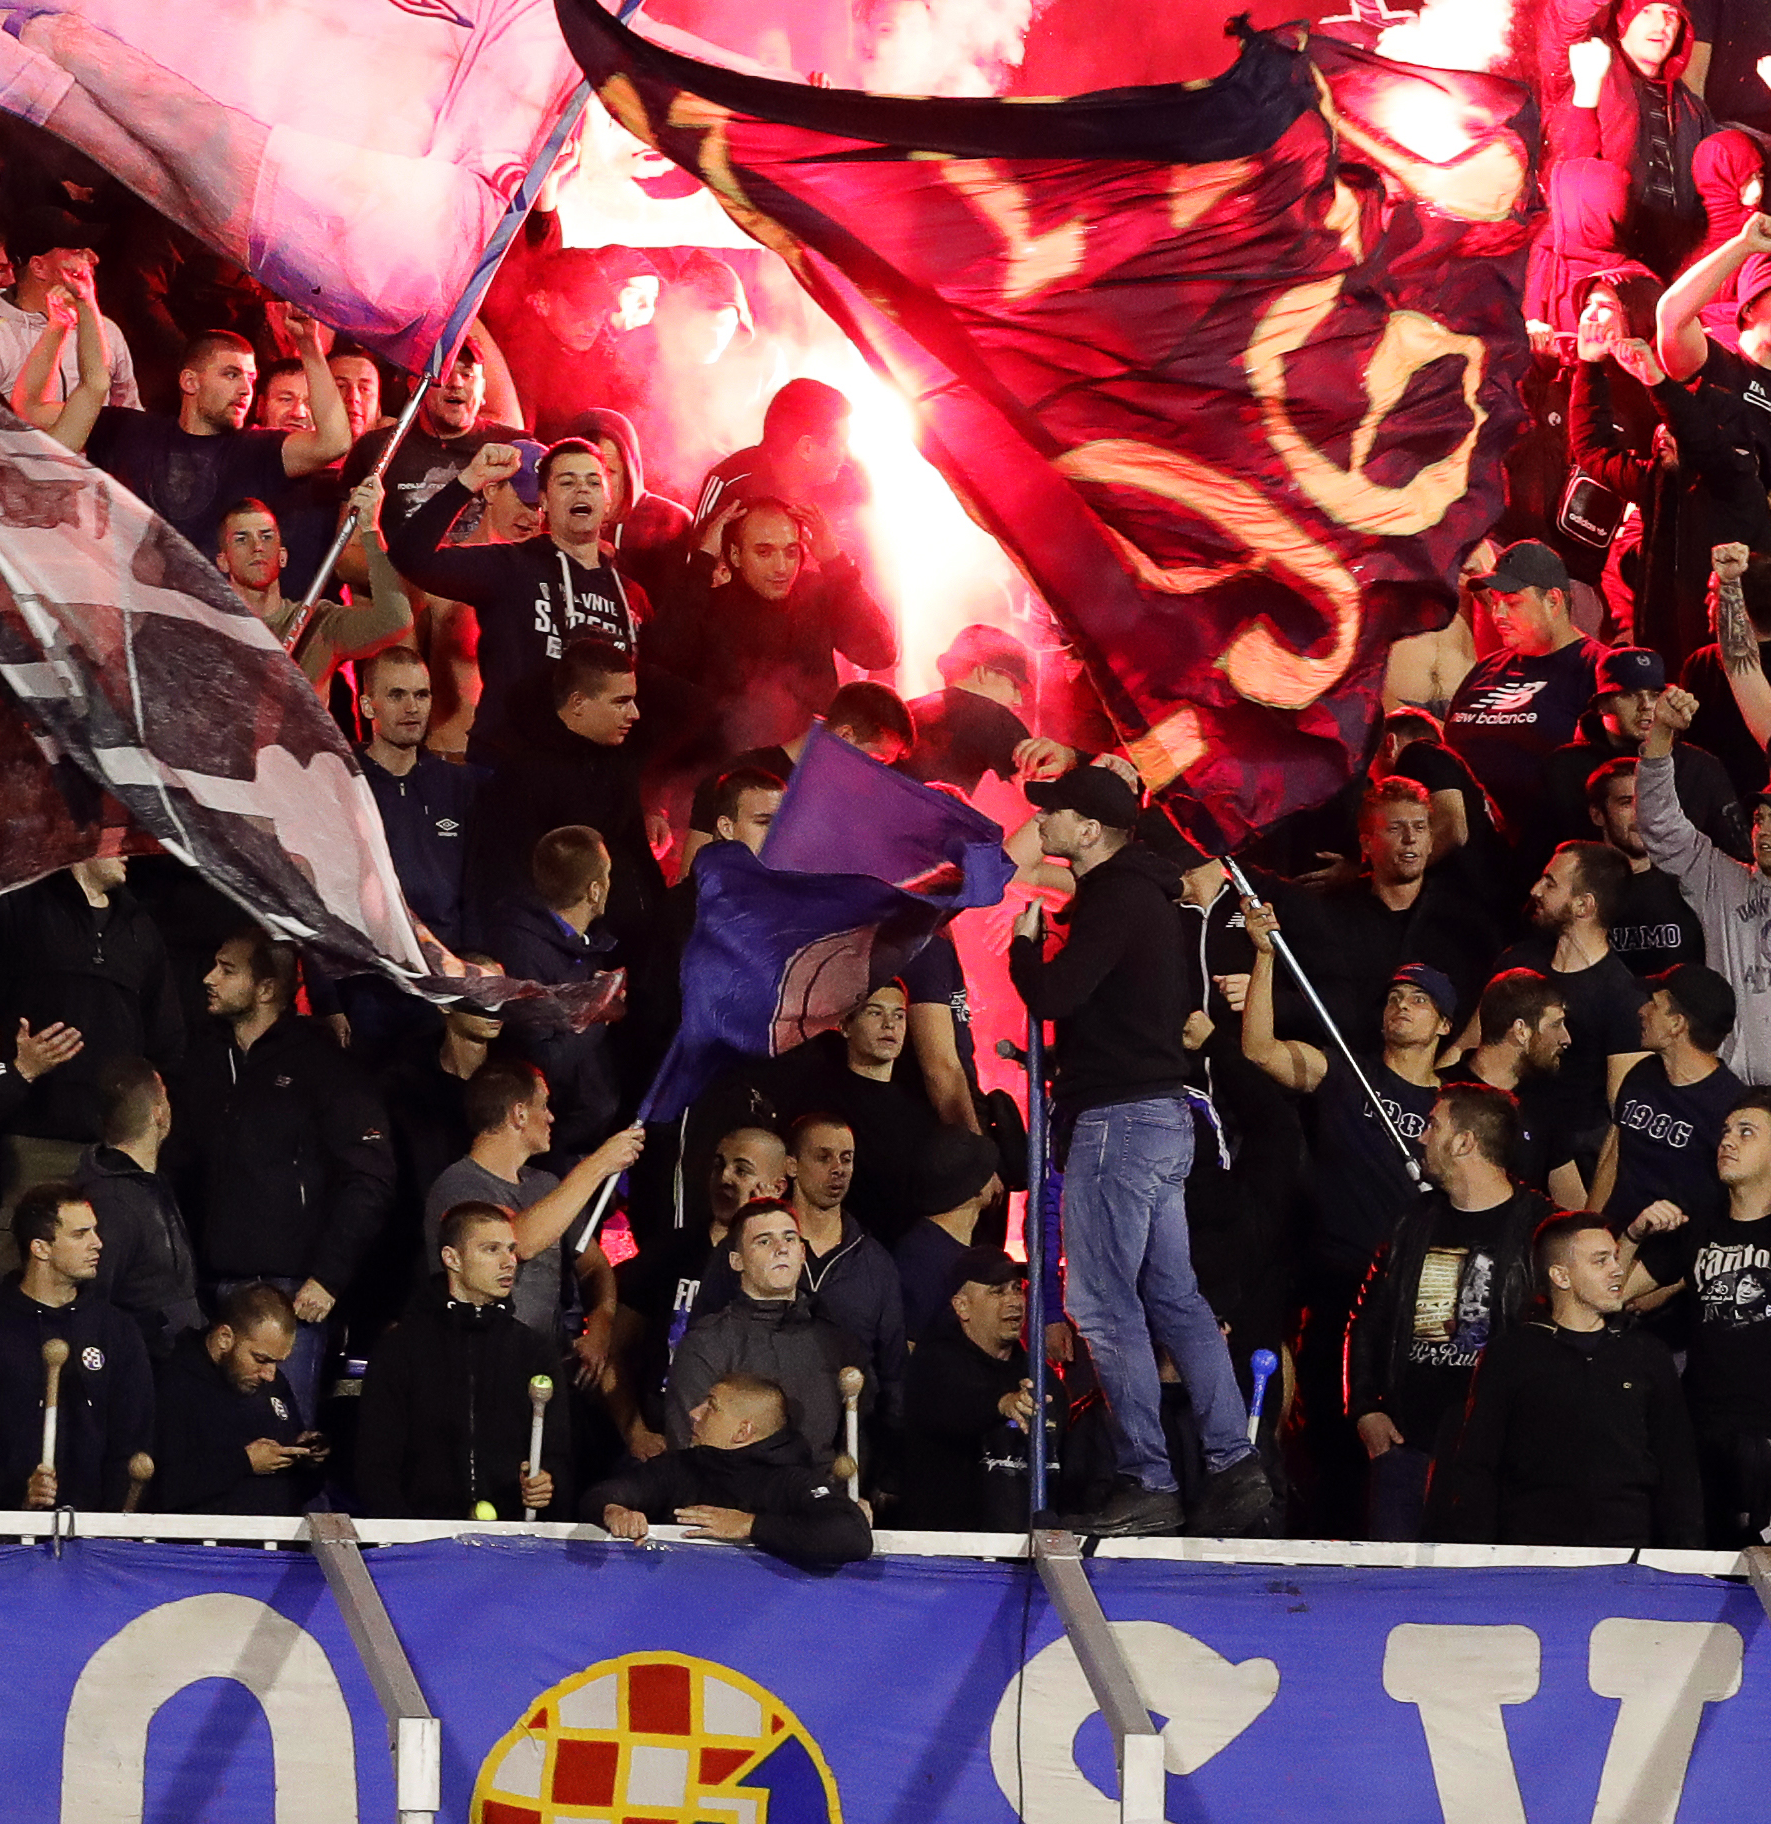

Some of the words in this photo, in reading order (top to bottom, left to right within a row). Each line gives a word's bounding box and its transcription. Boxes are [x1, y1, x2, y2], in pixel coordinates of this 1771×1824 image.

[1475, 711, 1538, 725] balance
[1609, 922, 1683, 953] NAMO
[1363, 1092, 1426, 1138] 198
[1619, 1098, 1694, 1148] 1986
